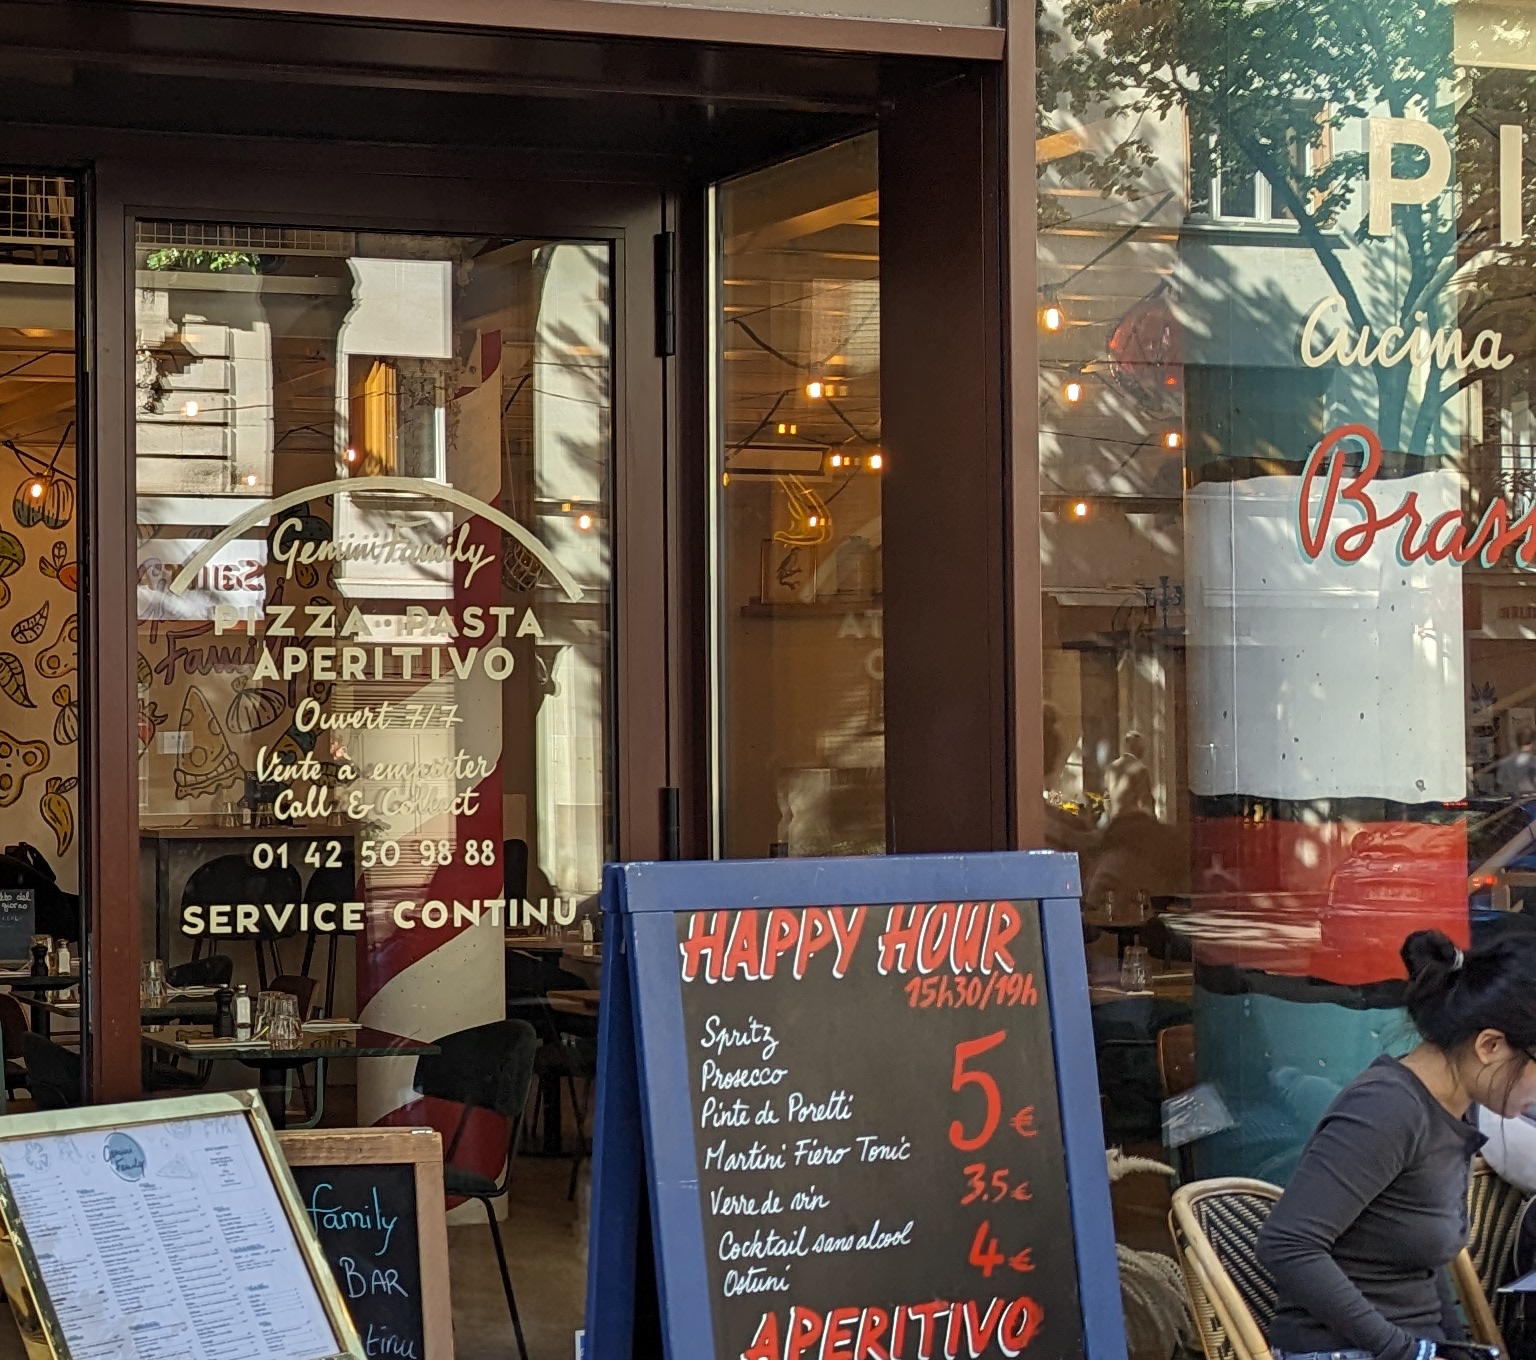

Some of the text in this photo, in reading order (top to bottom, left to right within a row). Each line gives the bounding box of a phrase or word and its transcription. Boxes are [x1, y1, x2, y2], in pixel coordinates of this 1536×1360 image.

[1301, 294, 1514, 371] Cucina
[272, 517, 381, 580] Gemini
[373, 516, 495, 589] Family
[215, 604, 545, 638] PIZZA PASTA
[252, 644, 515, 682] APERITIVO
[295, 696, 464, 734] Ouvert 7/7
[256, 745, 322, 783] Vente
[372, 748, 498, 790] emporter
[347, 794, 375, 820] &
[380, 786, 480, 819] Collect
[252, 839, 496, 870] 01 42 50 98 88
[181, 897, 577, 936] SERVICE CONTINU
[679, 900, 1022, 985] HAPPY HOUR
[904, 968, 1039, 1010] 15h30/19h
[700, 1014, 780, 1061] Spritz
[701, 1058, 788, 1093] Prosecco
[701, 1089, 855, 1128] Pinte de Poretti
[704, 1134, 912, 1171] Martini Fiero Tonic
[306, 1183, 399, 1257] family
[710, 1185, 830, 1217] Verre de vin
[718, 1220, 915, 1262] Cocktail sans alcool
[340, 1256, 409, 1299] BAR
[723, 1264, 791, 1298] Ostuni
[366, 1323, 418, 1360] tinu
